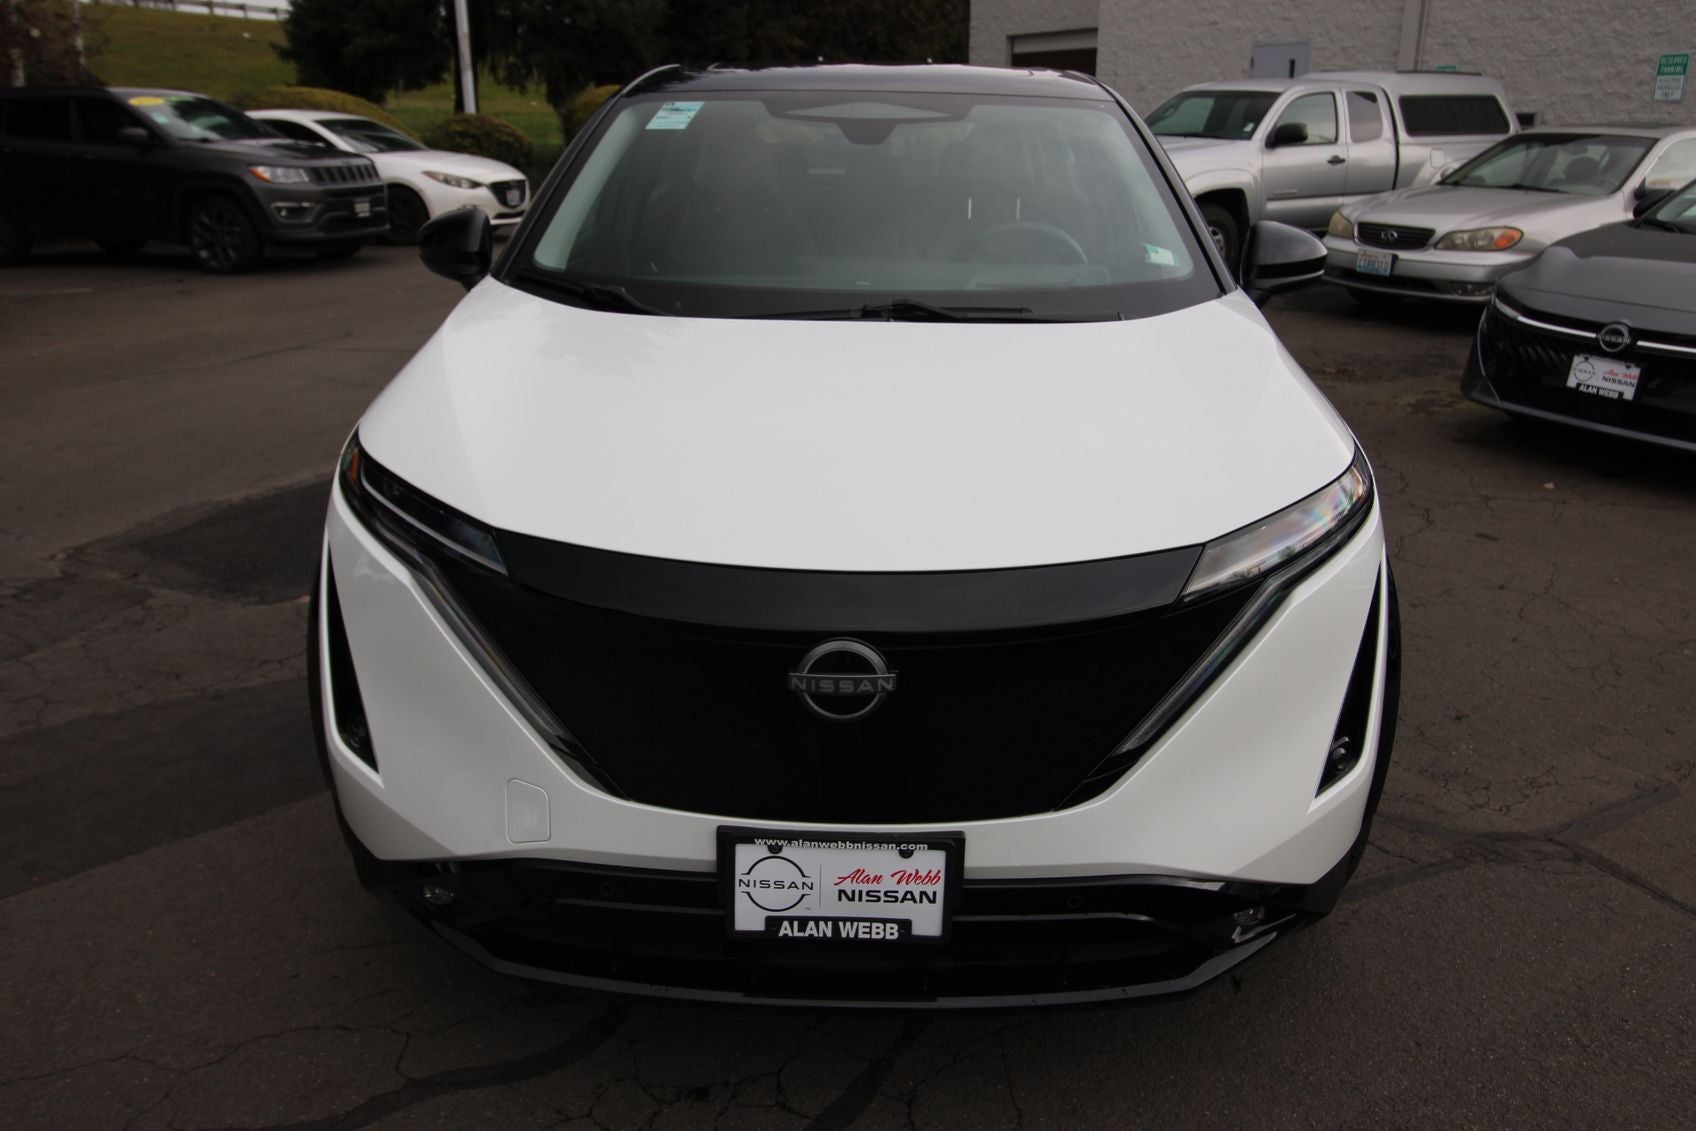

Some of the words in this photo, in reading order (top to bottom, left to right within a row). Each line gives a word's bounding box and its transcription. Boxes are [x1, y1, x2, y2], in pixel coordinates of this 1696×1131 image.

[1578, 384, 1598, 394] ALAN
[1602, 376, 1636, 388] NISSAN
[791, 677, 894, 693] NISSAN
[754, 838, 929, 851] www.alanwebbnissan.com
[833, 868, 884, 886] Alan
[890, 869, 942, 886] Webb
[738, 878, 815, 891] NISSAN
[837, 889, 937, 905] NISSAN
[778, 920, 833, 938] ALAN
[838, 922, 900, 940] WEBB
